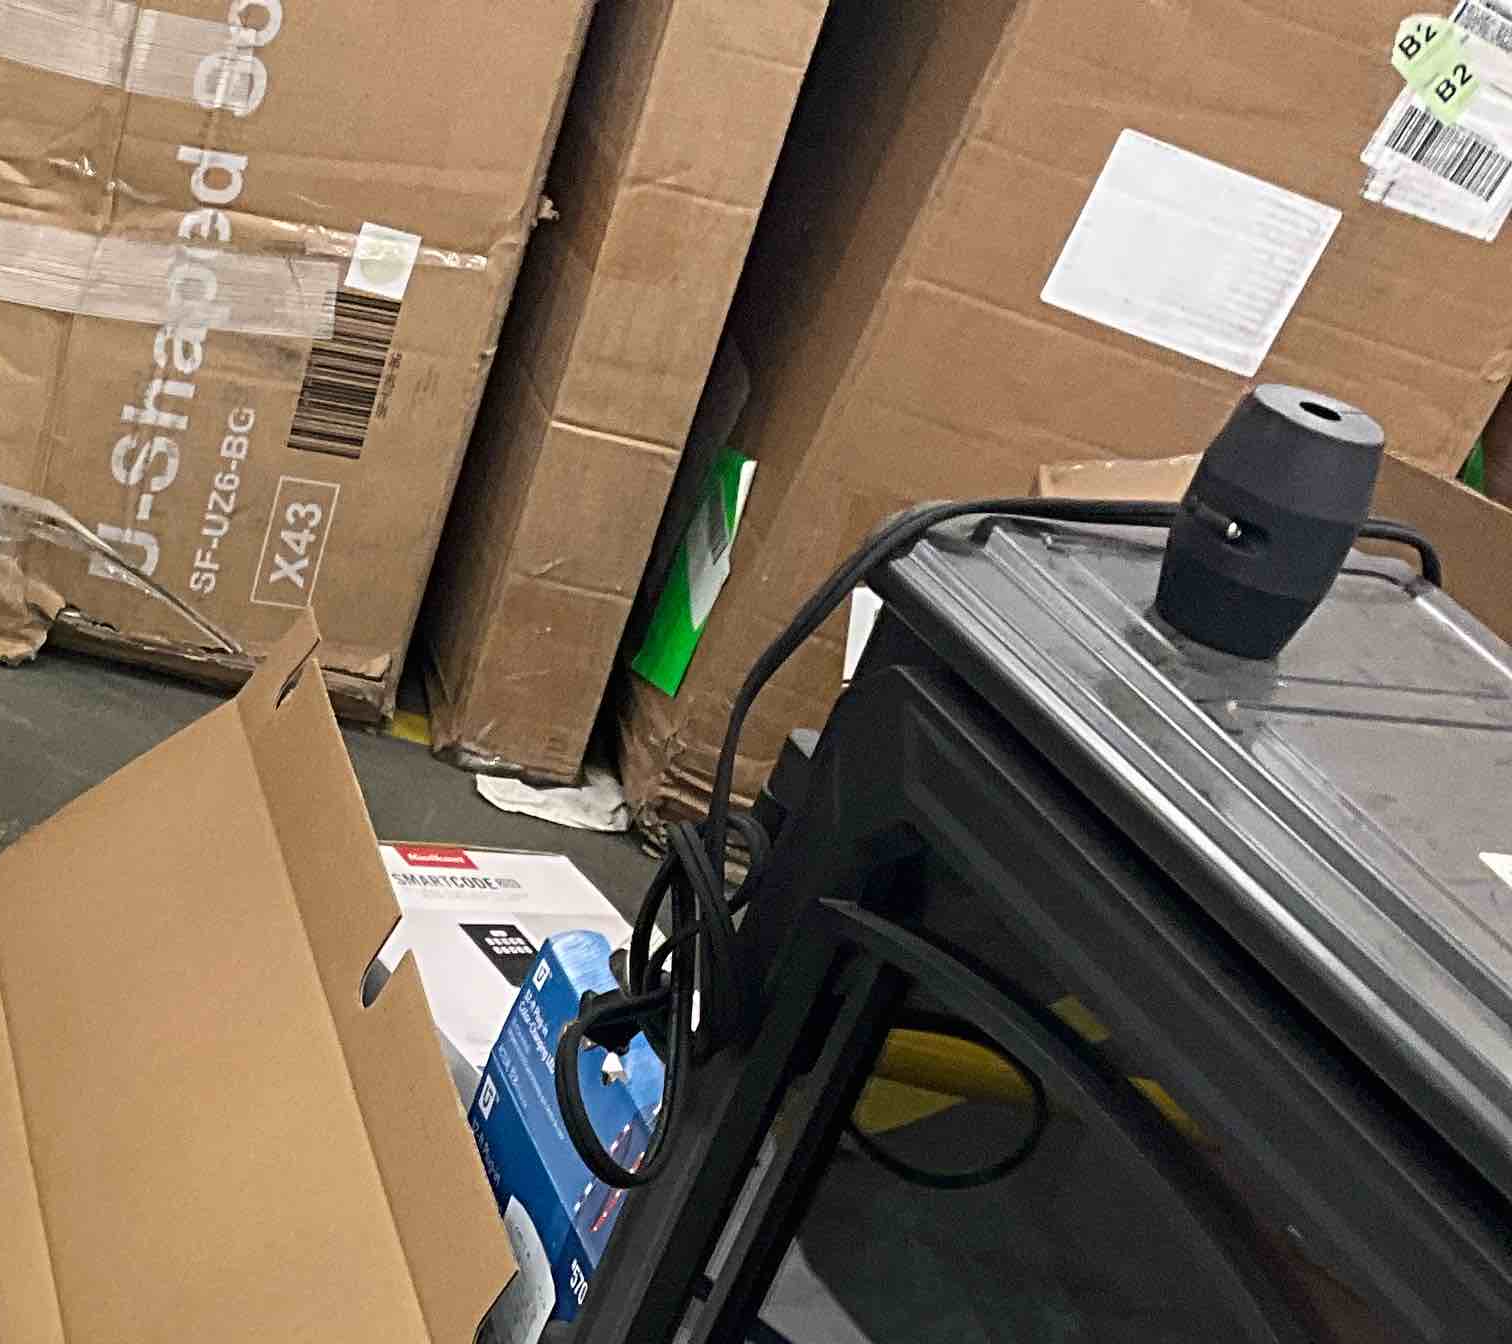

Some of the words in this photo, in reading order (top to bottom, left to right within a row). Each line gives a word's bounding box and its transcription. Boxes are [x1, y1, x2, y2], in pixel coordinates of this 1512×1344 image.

[1433, 64, 1473, 105] B2
[88, 145, 250, 580] U-Shaped
[189, 406, 257, 595] SF-UZ6-BG
[268, 502, 323, 590] X43
[392, 873, 498, 889] SMARTCODE
